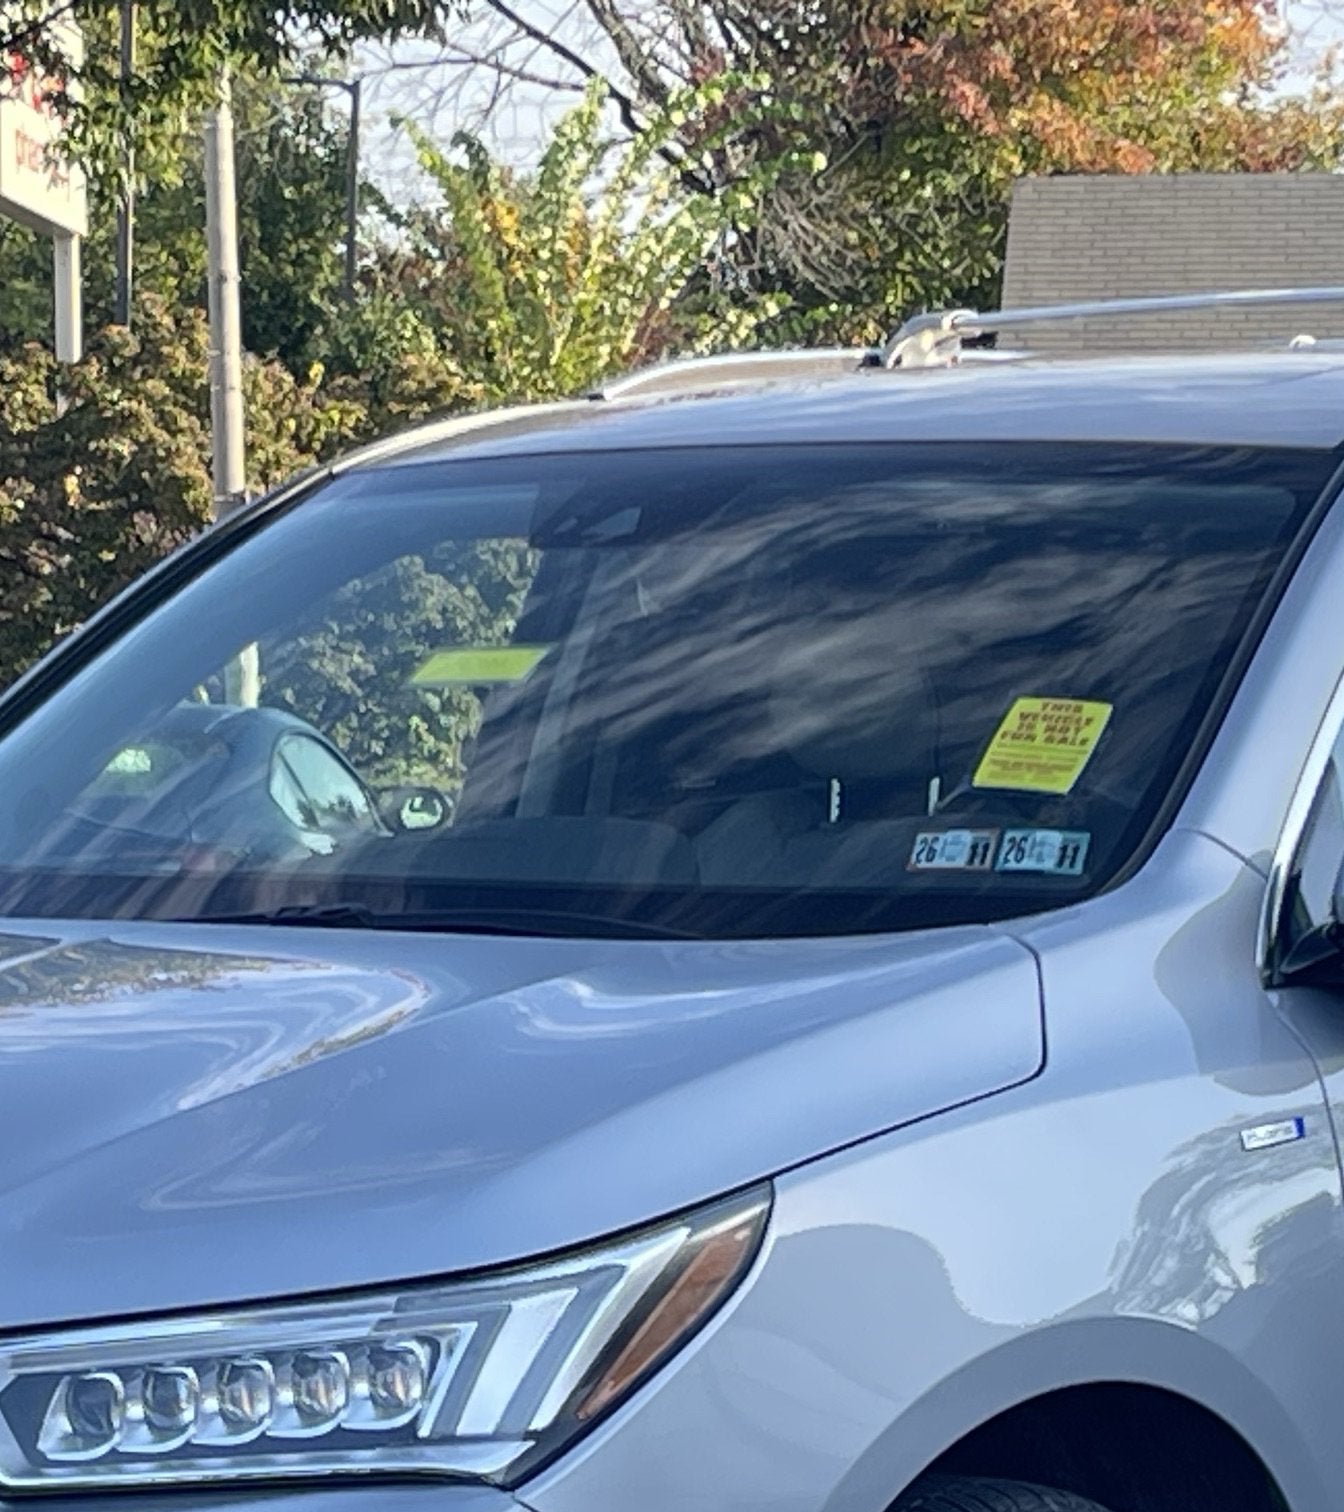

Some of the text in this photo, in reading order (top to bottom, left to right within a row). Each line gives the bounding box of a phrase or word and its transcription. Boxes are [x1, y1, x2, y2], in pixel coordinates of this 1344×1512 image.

[915, 836, 990, 867] 26 11
[1004, 836, 1081, 869] 26 11
